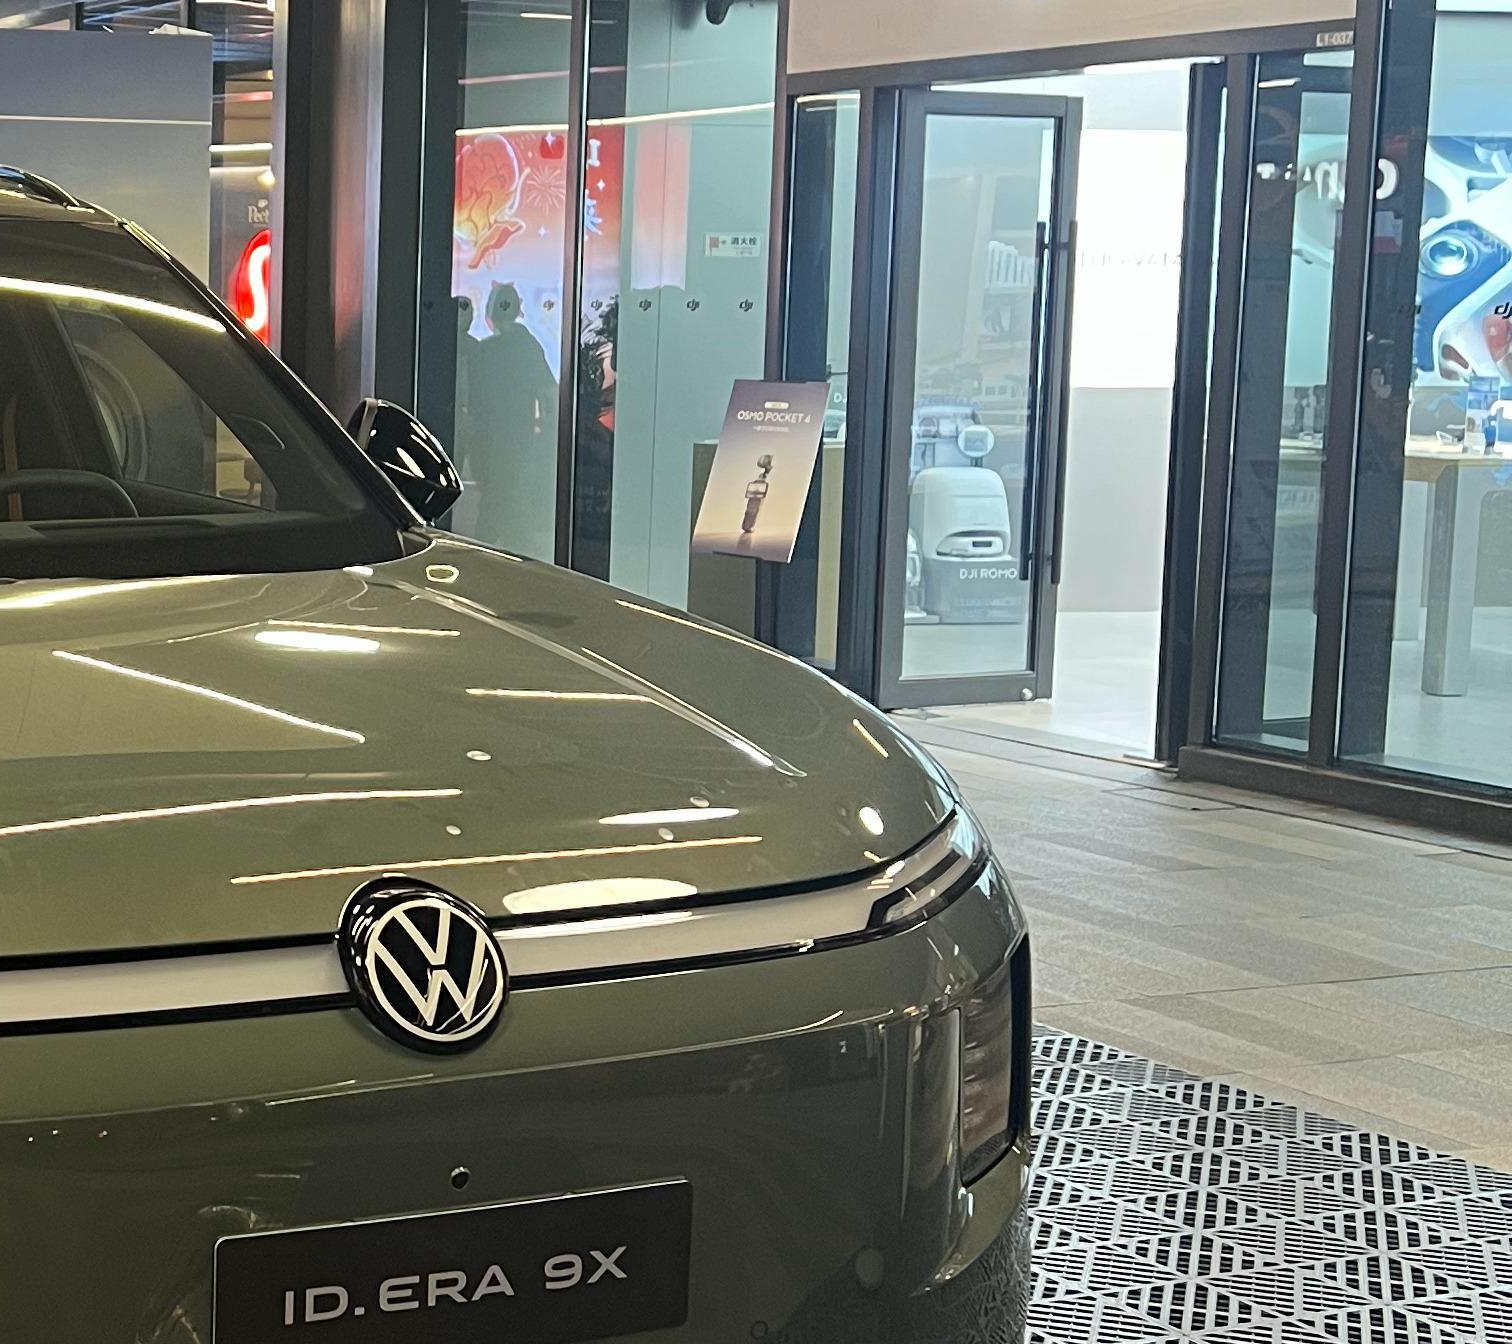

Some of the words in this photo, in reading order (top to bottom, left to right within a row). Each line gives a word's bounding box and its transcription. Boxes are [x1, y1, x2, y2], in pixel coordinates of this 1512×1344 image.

[738, 410, 764, 422] OSMO
[765, 411, 805, 424] POCKET
[959, 568, 978, 580] DJI
[980, 568, 1018, 580] ROMO
[284, 1264, 515, 1326] ID.ERA
[544, 1246, 628, 1290] 9X
